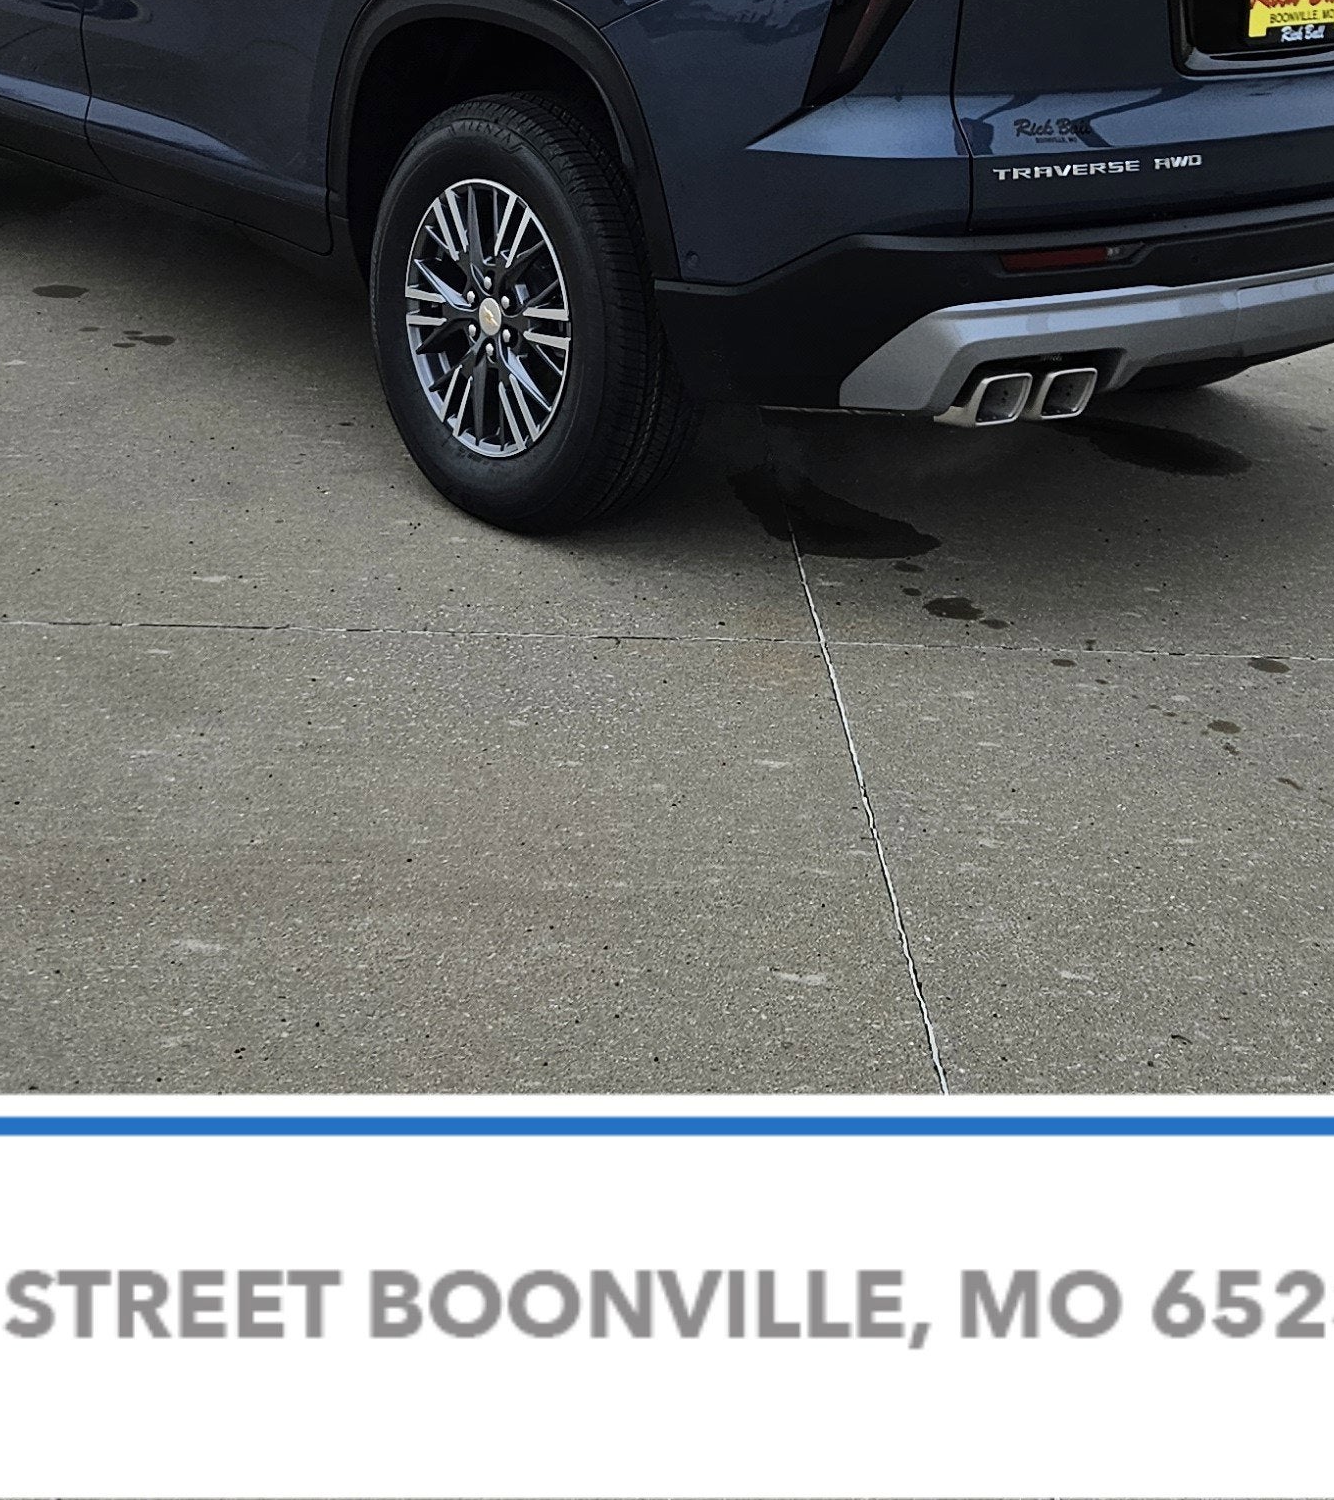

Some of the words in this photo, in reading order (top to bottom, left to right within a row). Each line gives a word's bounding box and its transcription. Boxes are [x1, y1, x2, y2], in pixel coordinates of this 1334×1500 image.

[1013, 117, 1055, 138] Rick
[993, 159, 1141, 181] TRAVERSE
[1153, 154, 1203, 171] AWD
